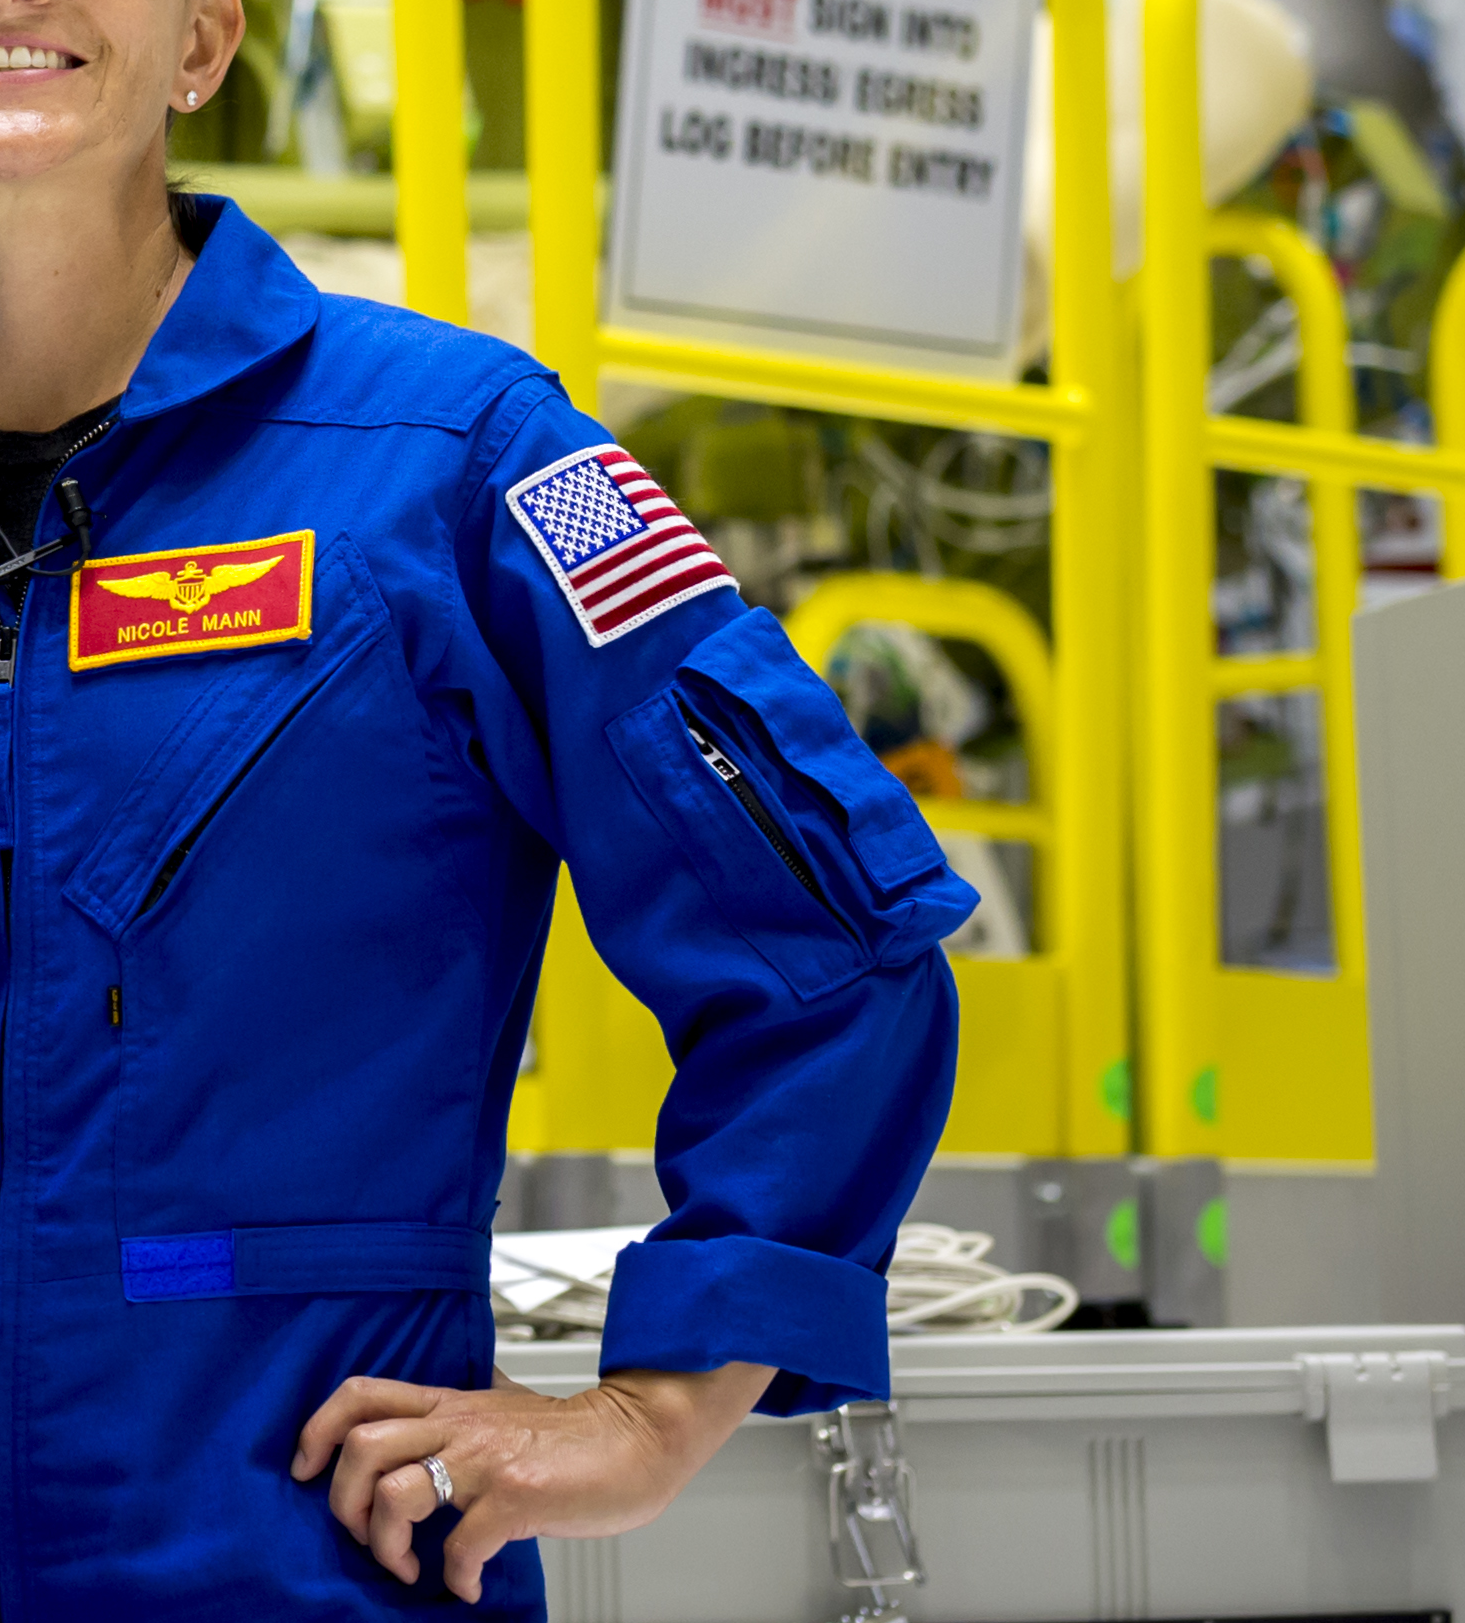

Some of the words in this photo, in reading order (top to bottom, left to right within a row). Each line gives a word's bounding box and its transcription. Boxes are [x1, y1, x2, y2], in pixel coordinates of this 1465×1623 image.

[903, 14, 979, 59] INTO
[688, 44, 838, 100] INGRESS
[857, 75, 983, 129] EGRESS
[662, 112, 730, 160] LOG
[747, 124, 875, 183] BEFORE
[891, 150, 994, 200] ENTRY
[116, 619, 190, 644] NICOLE
[201, 608, 263, 633] MANN
